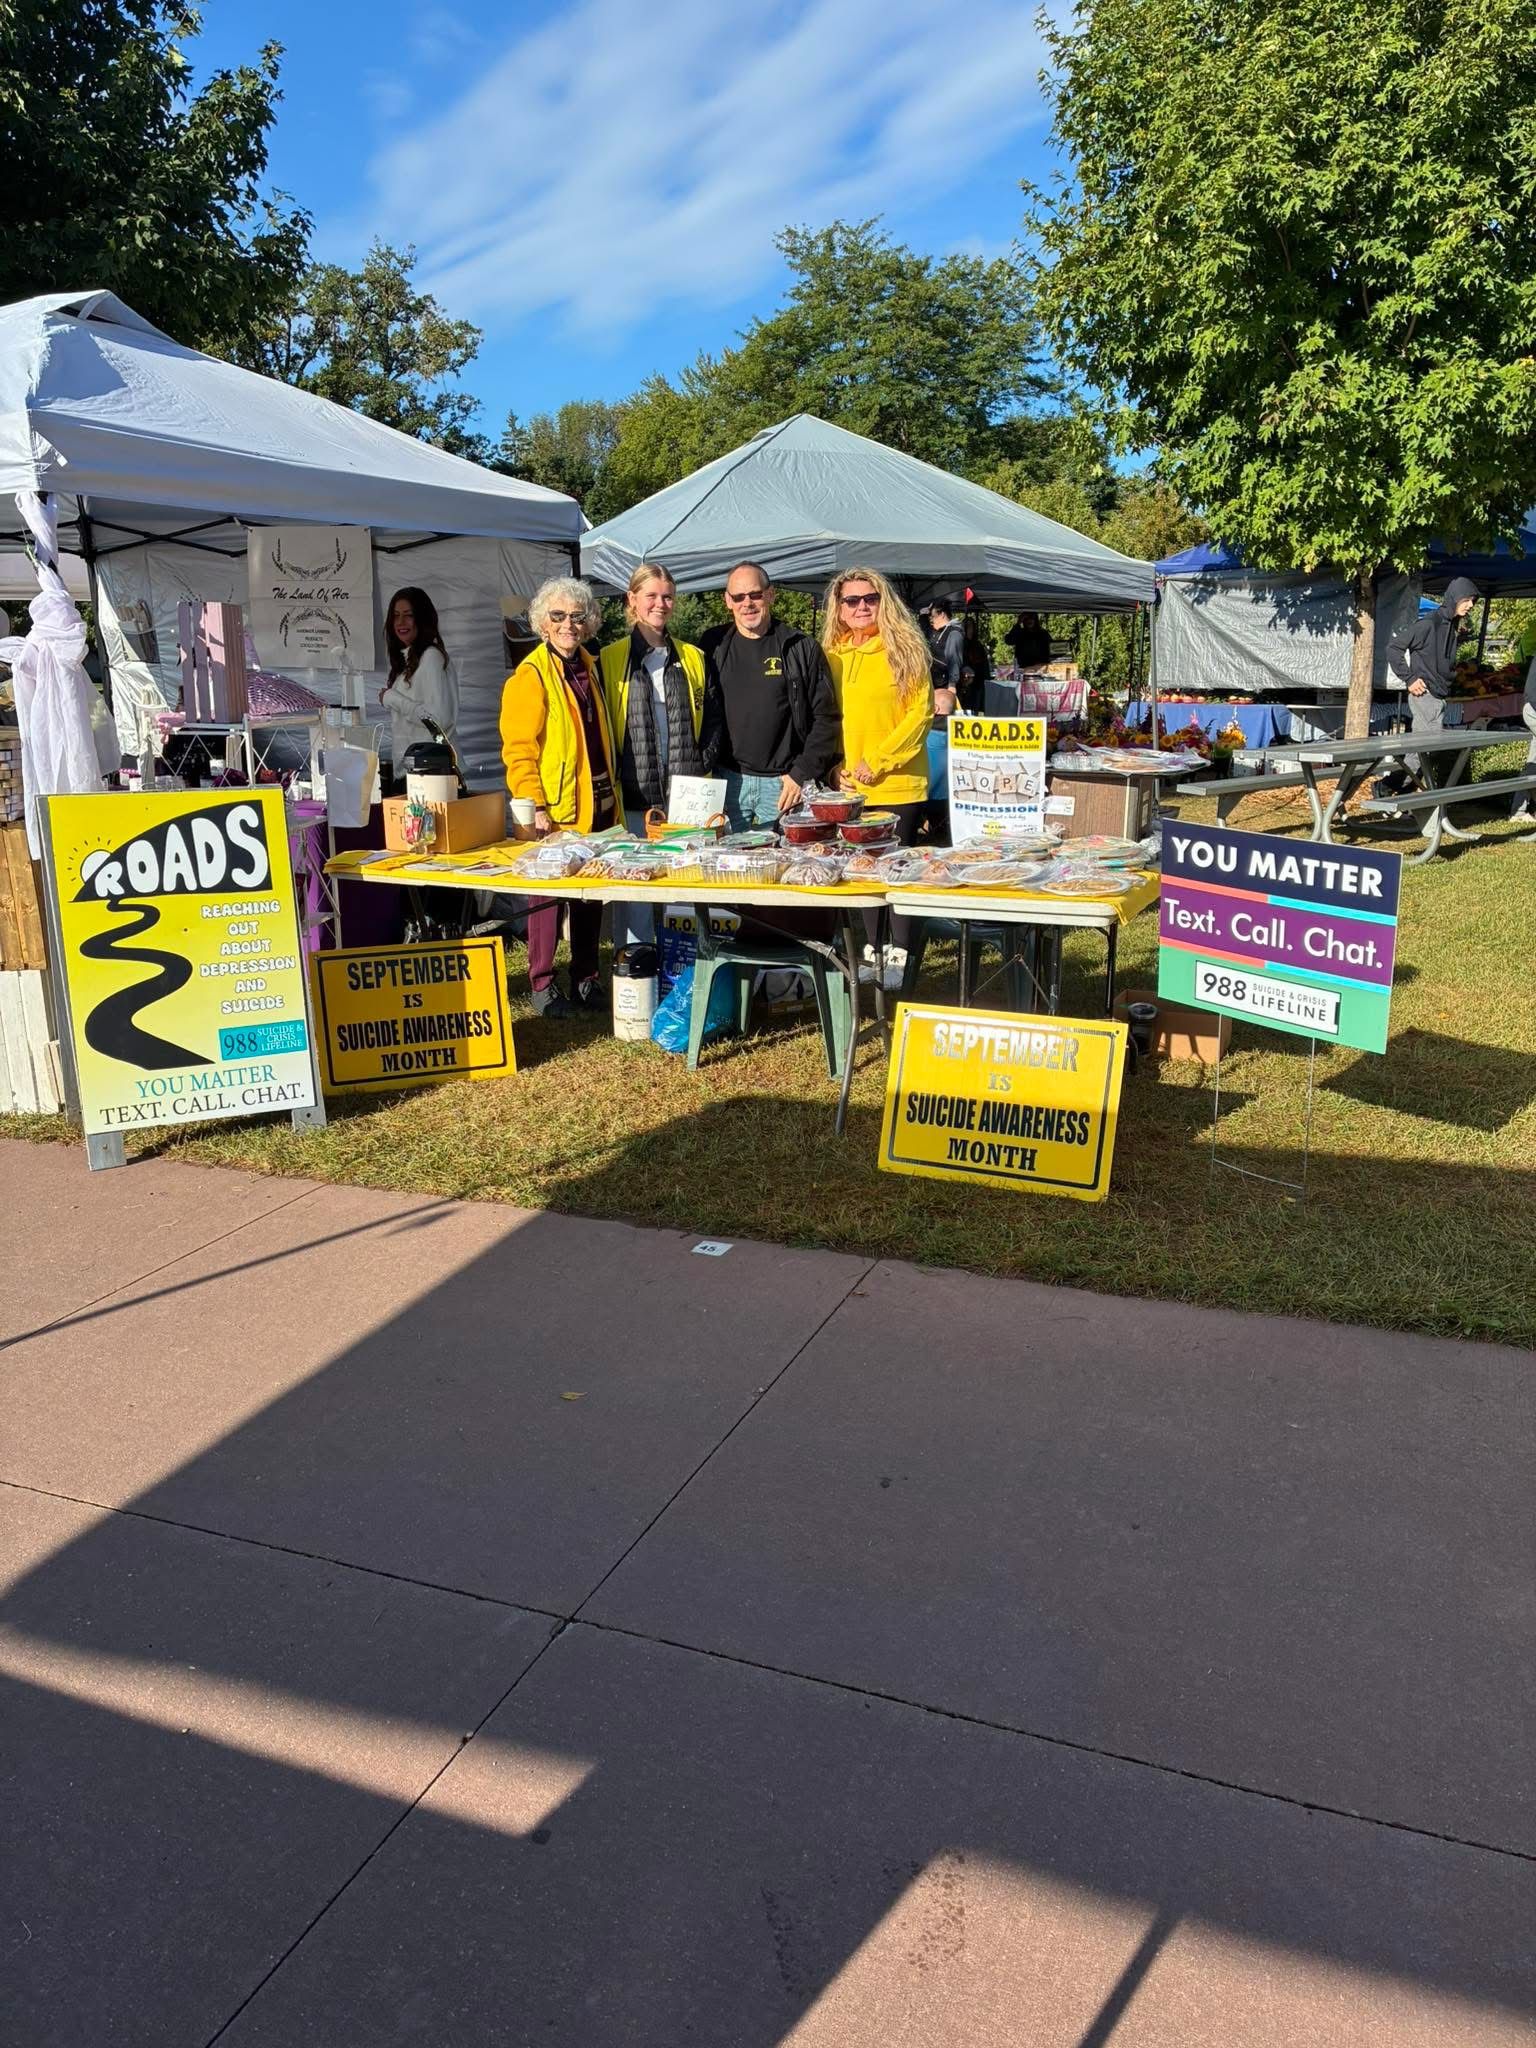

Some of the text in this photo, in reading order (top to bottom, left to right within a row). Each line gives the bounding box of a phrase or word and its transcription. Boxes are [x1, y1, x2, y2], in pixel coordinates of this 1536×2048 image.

[272, 587, 349, 602] The Land Of Her
[954, 721, 1040, 741] R.O.A.D.S.
[955, 802, 1038, 812] DEPRESSION
[95, 805, 268, 897] ROADS
[1171, 837, 1383, 897] YOU MATTER
[201, 900, 280, 918] REACHING
[228, 921, 259, 935] OUT
[1164, 898, 1383, 968] Text. Call. Chat.
[220, 939, 271, 956] ABOUT
[200, 956, 296, 977] DEPRESSION
[347, 954, 471, 991] SEPTEMBER
[235, 978, 266, 993] AND
[1204, 973, 1327, 1007] 988 SUICIDE & CRISIS
[221, 995, 285, 1014] SUICIDE
[402, 993, 423, 1008] IS
[1252, 993, 1326, 1021] LIFELINE
[257, 1025, 295, 1036] SUICIDE
[267, 1033, 296, 1043] CRISIS
[337, 1010, 492, 1052] SUICIDE AWARENESS
[224, 1032, 258, 1056] 988
[261, 1039, 303, 1051] LIFELINE
[933, 1023, 1079, 1072] SEPTEMBER
[381, 1047, 457, 1072] MONTH
[136, 1064, 277, 1098] YOU MATTER
[987, 1073, 1012, 1091] IS
[100, 1083, 305, 1125] TEXT. CALL. CHAT.
[906, 1091, 1090, 1146] SUICIDE AWARENESS
[947, 1137, 1038, 1171] MONTH
